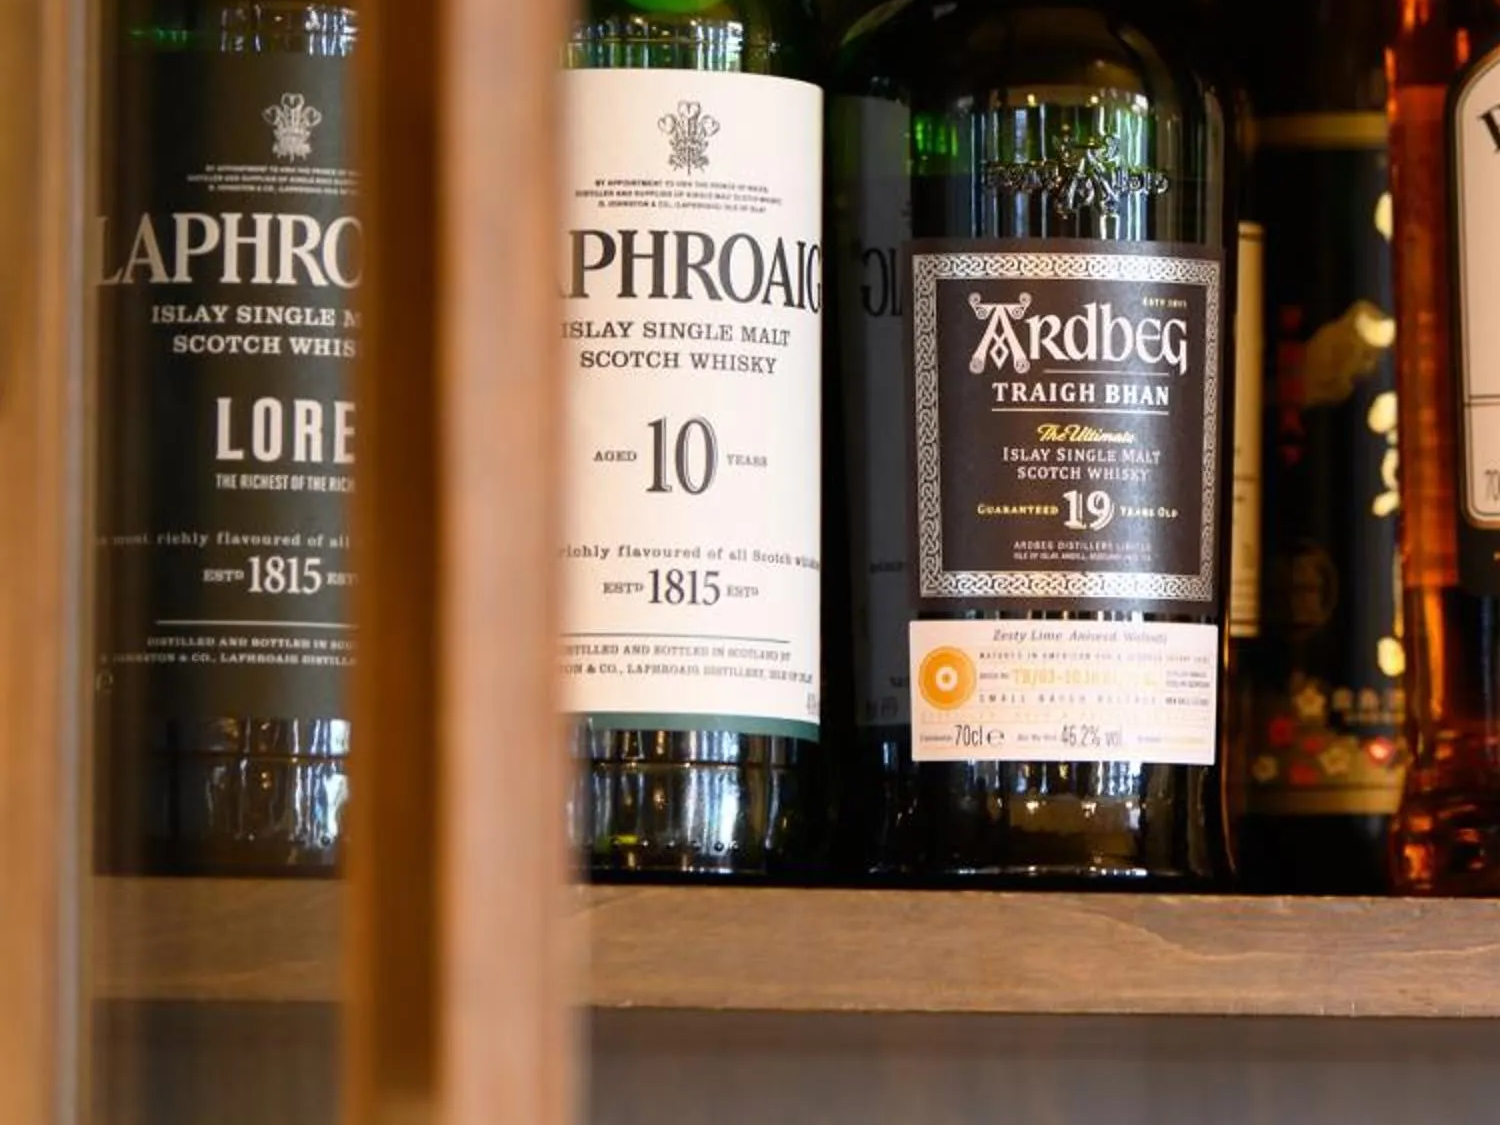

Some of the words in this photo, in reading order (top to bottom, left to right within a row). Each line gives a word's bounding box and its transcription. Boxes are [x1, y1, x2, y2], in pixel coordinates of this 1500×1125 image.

[152, 305, 229, 323] ISLAY
[236, 306, 335, 326] SINGLE
[561, 321, 634, 340] ISLAY
[642, 322, 733, 343] SINGLE
[741, 326, 791, 346] MALT
[968, 292, 1187, 375] Ardbeg
[173, 335, 281, 354] SCOTCH
[580, 350, 680, 369] SCOTCH
[690, 353, 777, 374] WHISKY
[992, 382, 1095, 403] TRAIGH
[1103, 383, 1169, 406] BHAN
[215, 396, 356, 463] LORE
[1036, 424, 1066, 443] The
[593, 450, 637, 463] AGED
[645, 416, 718, 496] 10
[726, 453, 768, 468] YEARS
[1003, 447, 1050, 462] ISLAY
[1056, 447, 1117, 463] SINGLE
[1121, 448, 1161, 465] MALT
[215, 473, 237, 490] THE
[240, 473, 288, 491] RICHEST
[304, 475, 327, 492] THE
[1017, 466, 1081, 480] SCOTCH
[1086, 467, 1150, 482] WHISKY
[1062, 489, 1115, 532] 19
[157, 530, 207, 548] richly
[216, 530, 300, 547] flavoured
[307, 532, 325, 548] of
[617, 544, 701, 560] flavoured
[707, 545, 723, 561] of
[729, 547, 748, 561] all
[248, 556, 322, 594] 1815
[648, 568, 721, 606] 1815
[218, 636, 248, 647] AND
[251, 637, 310, 649] BOTTLED
[992, 628, 1027, 644] Zesty
[1031, 628, 1063, 643] Lime
[623, 644, 651, 655] AND
[955, 724, 983, 747] 70cl
[1104, 725, 1123, 747] vol
